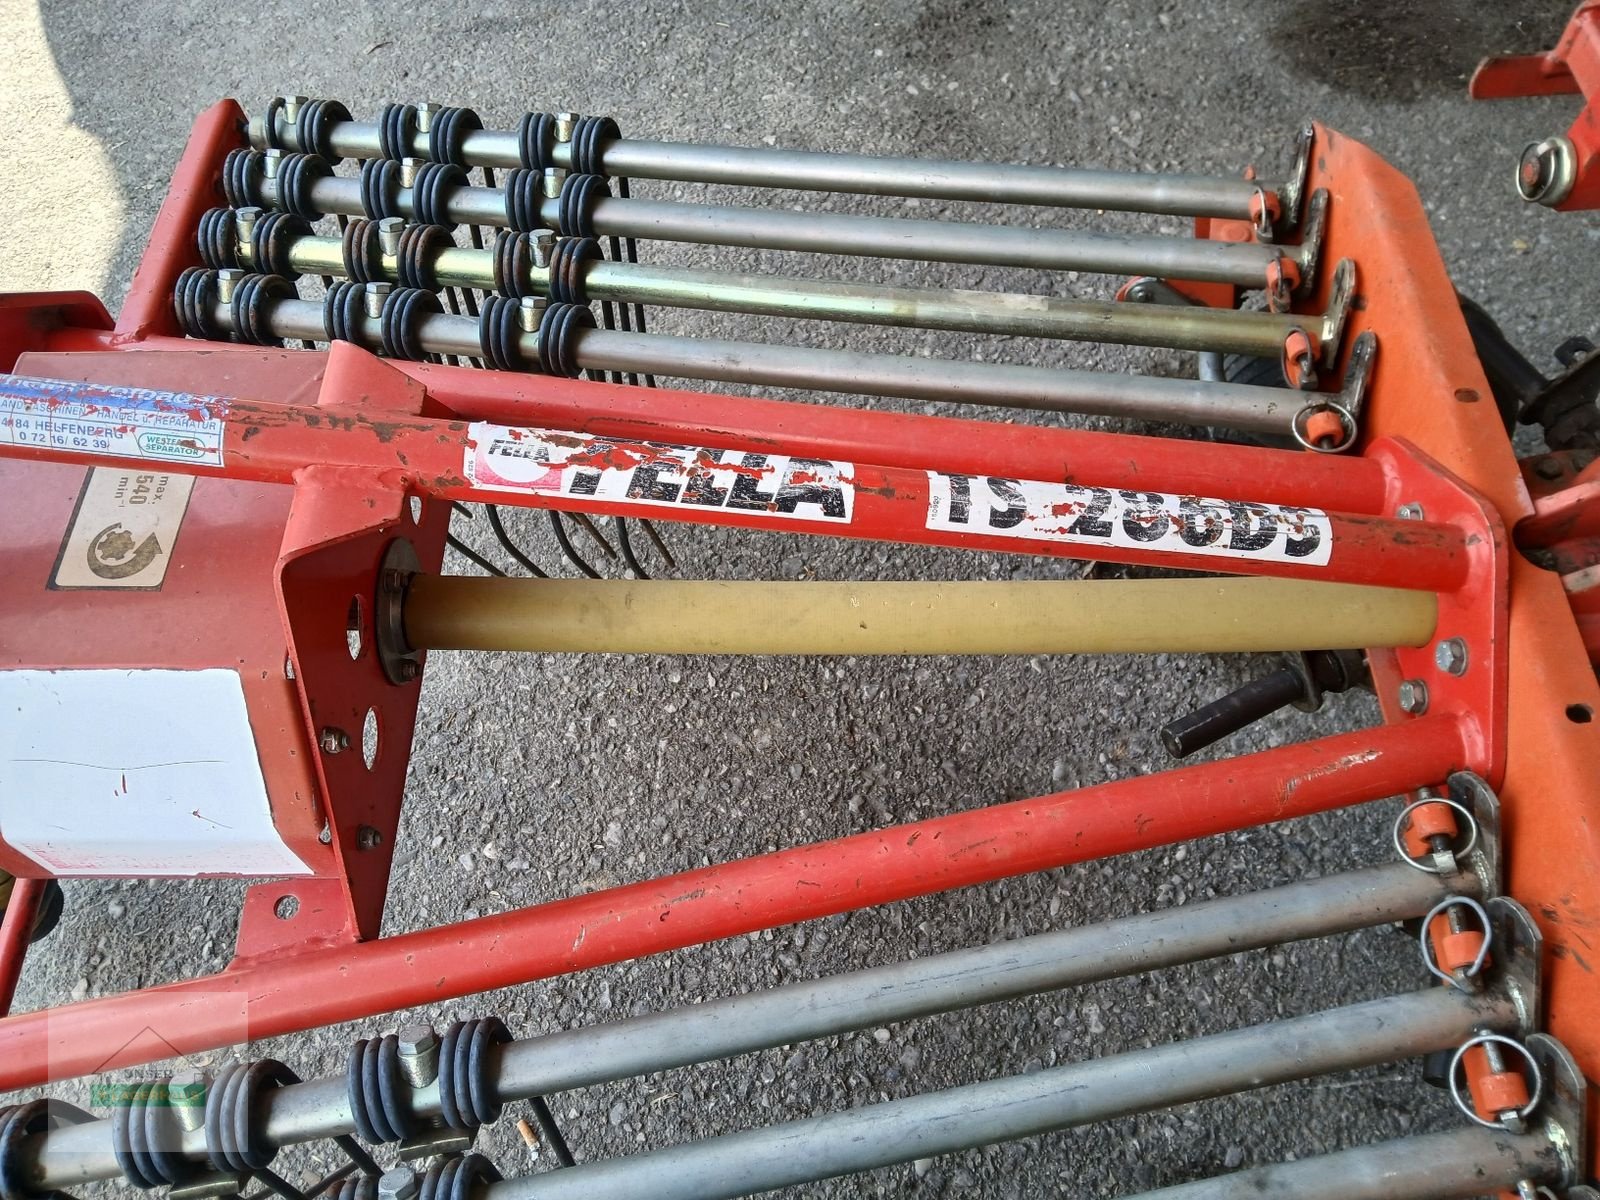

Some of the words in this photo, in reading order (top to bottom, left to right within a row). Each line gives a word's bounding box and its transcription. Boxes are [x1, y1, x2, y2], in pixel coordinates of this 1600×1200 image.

[19, 431, 27, 441] 0
[31, 433, 46, 443] 72
[73, 437, 88, 447] 62
[35, 420, 123, 440] HELFENBERG
[145, 443, 199, 456] SEPARATOR
[129, 475, 155, 505] 540
[937, 471, 1028, 529] TS
